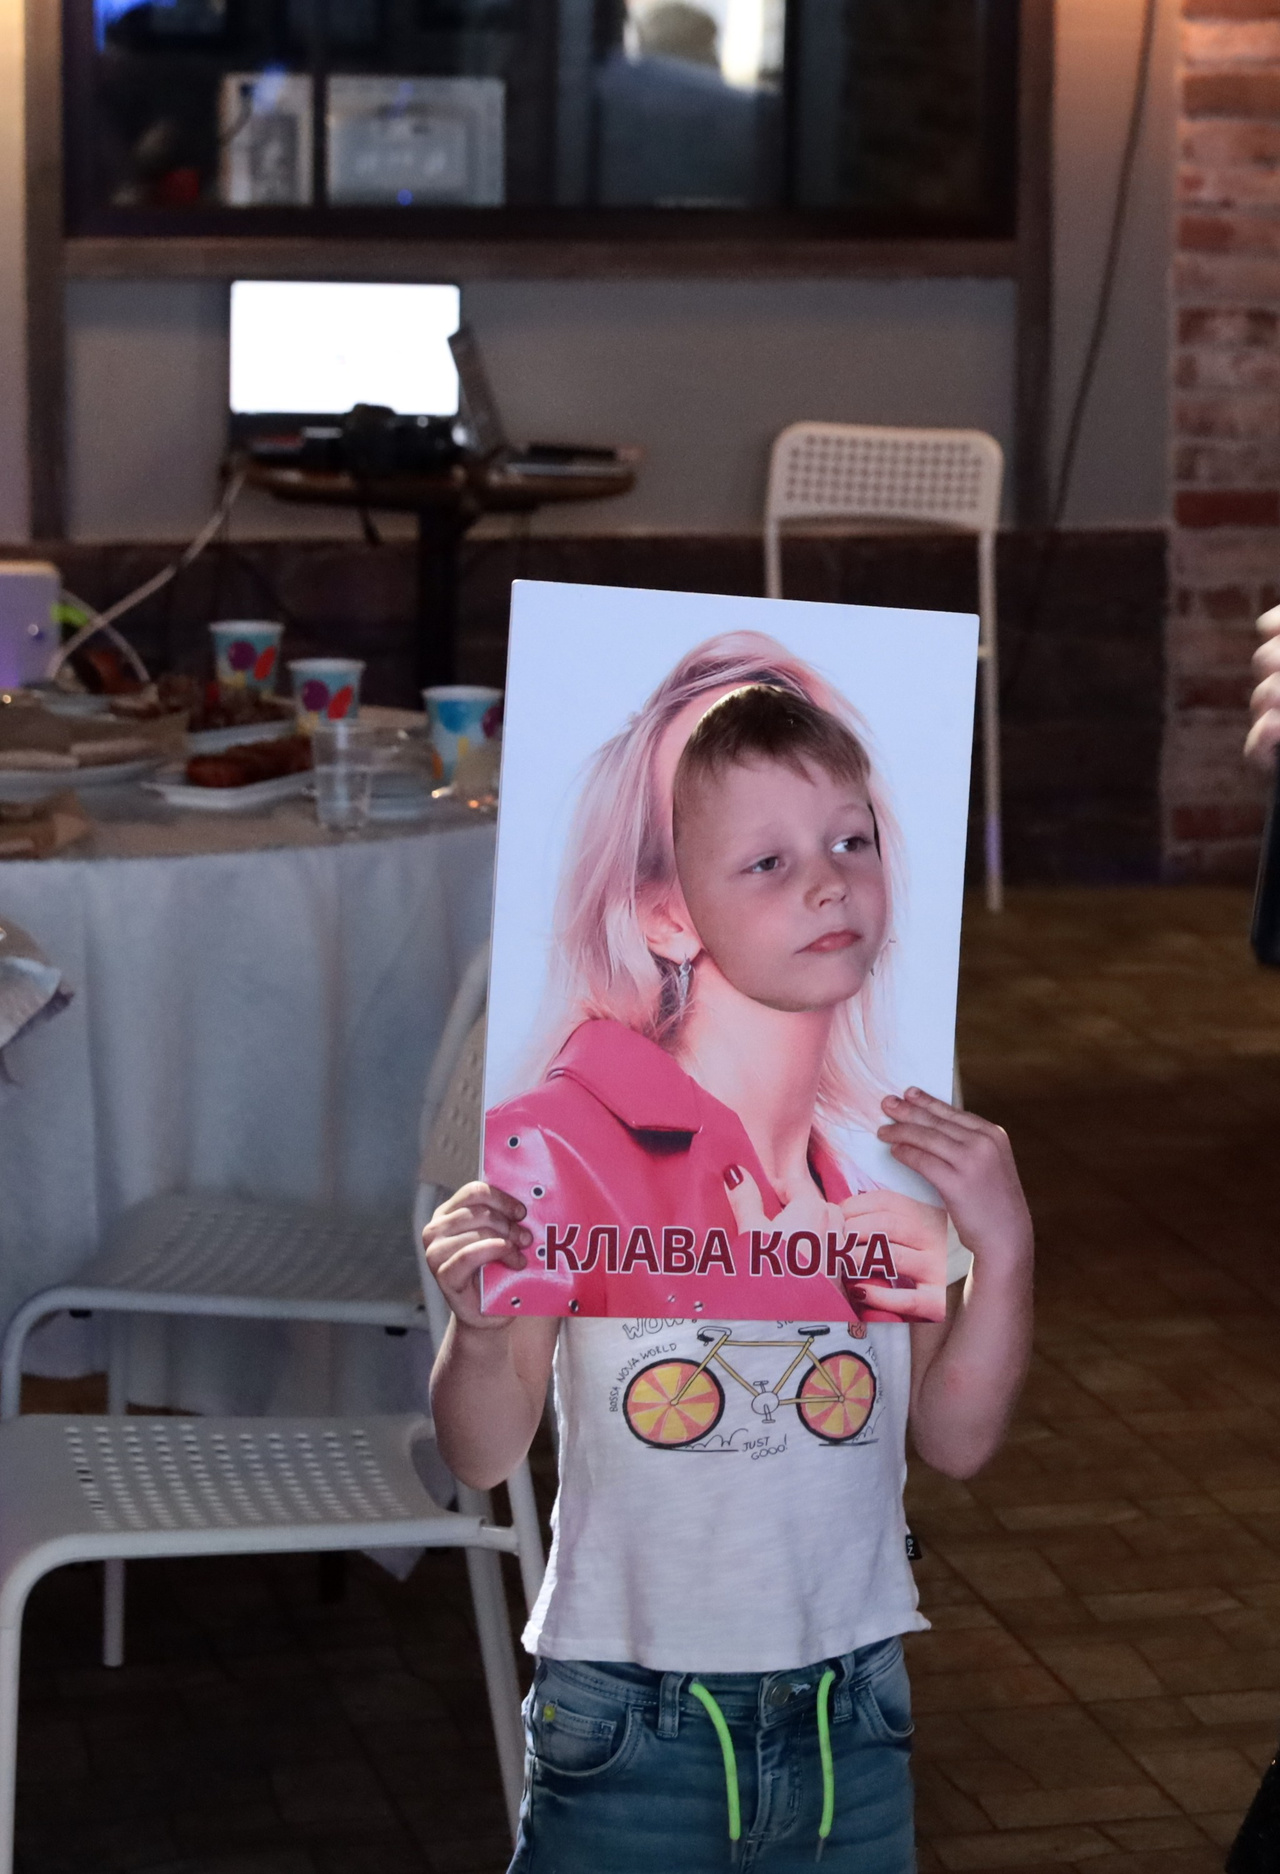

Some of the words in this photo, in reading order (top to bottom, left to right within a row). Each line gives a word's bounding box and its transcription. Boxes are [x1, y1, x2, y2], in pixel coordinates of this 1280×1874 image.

[545, 1223, 737, 1277] КЛАВА
[750, 1229, 898, 1279] КОКА
[622, 1317, 698, 1340] WO
[609, 1385, 621, 1412] BOSSA
[616, 1357, 640, 1383] NOVA
[639, 1342, 678, 1360] WORLD
[741, 1435, 771, 1453] JUST
